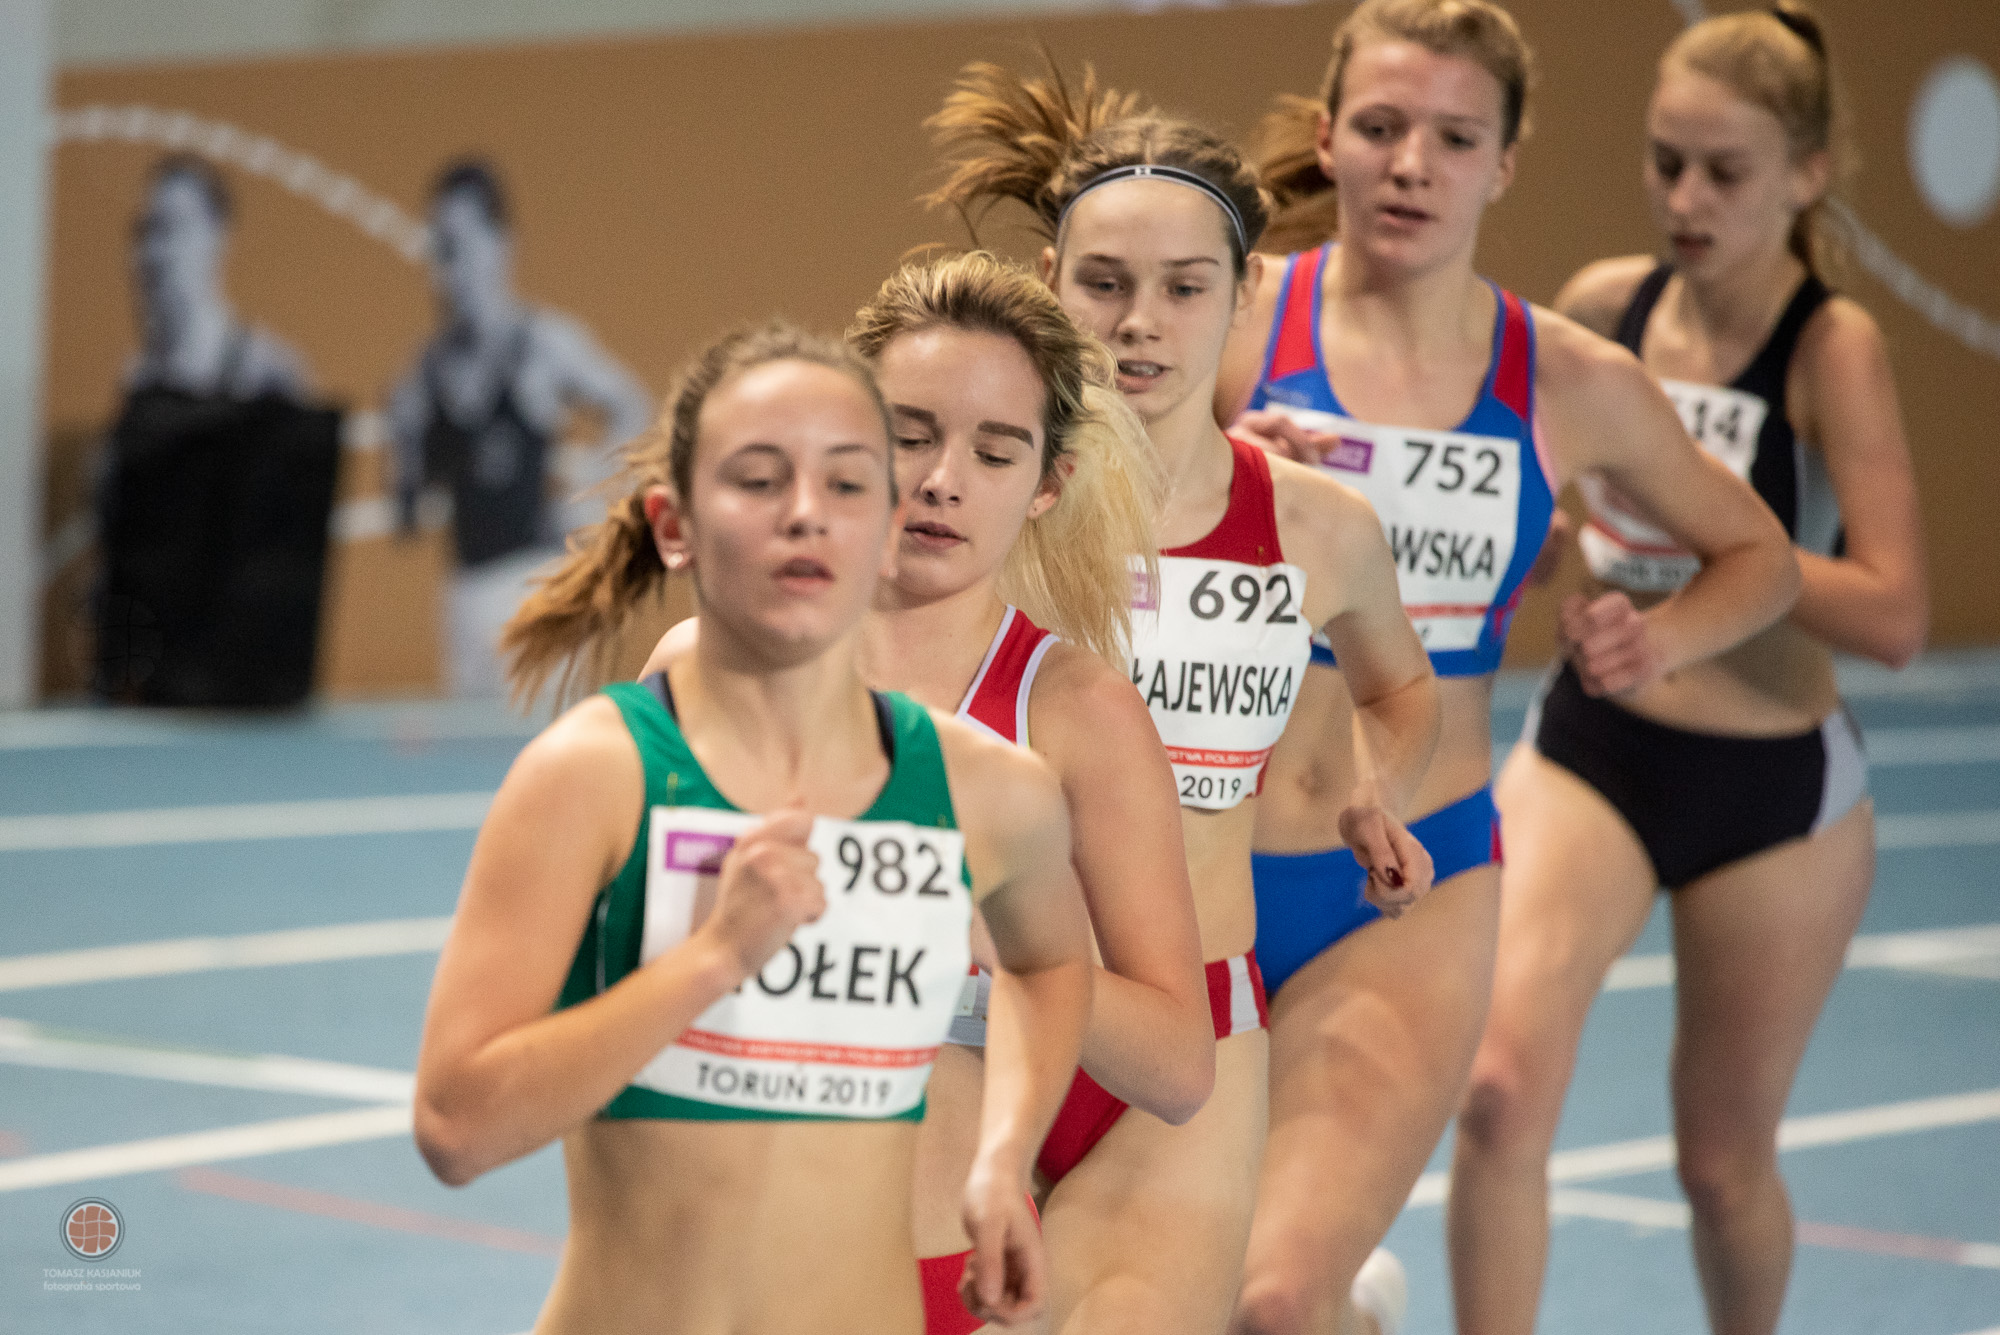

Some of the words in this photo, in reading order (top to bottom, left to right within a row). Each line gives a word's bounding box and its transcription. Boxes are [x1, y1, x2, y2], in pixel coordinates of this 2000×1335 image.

[1670, 395, 1743, 444] 14
[1404, 439, 1501, 497] 752
[1391, 524, 1495, 580] WSKA
[1189, 570, 1298, 624] 692
[1180, 775, 1241, 800] 2019
[837, 835, 950, 898] 982
[734, 942, 926, 1006] OŁEK
[819, 1074, 893, 1106] 2019
